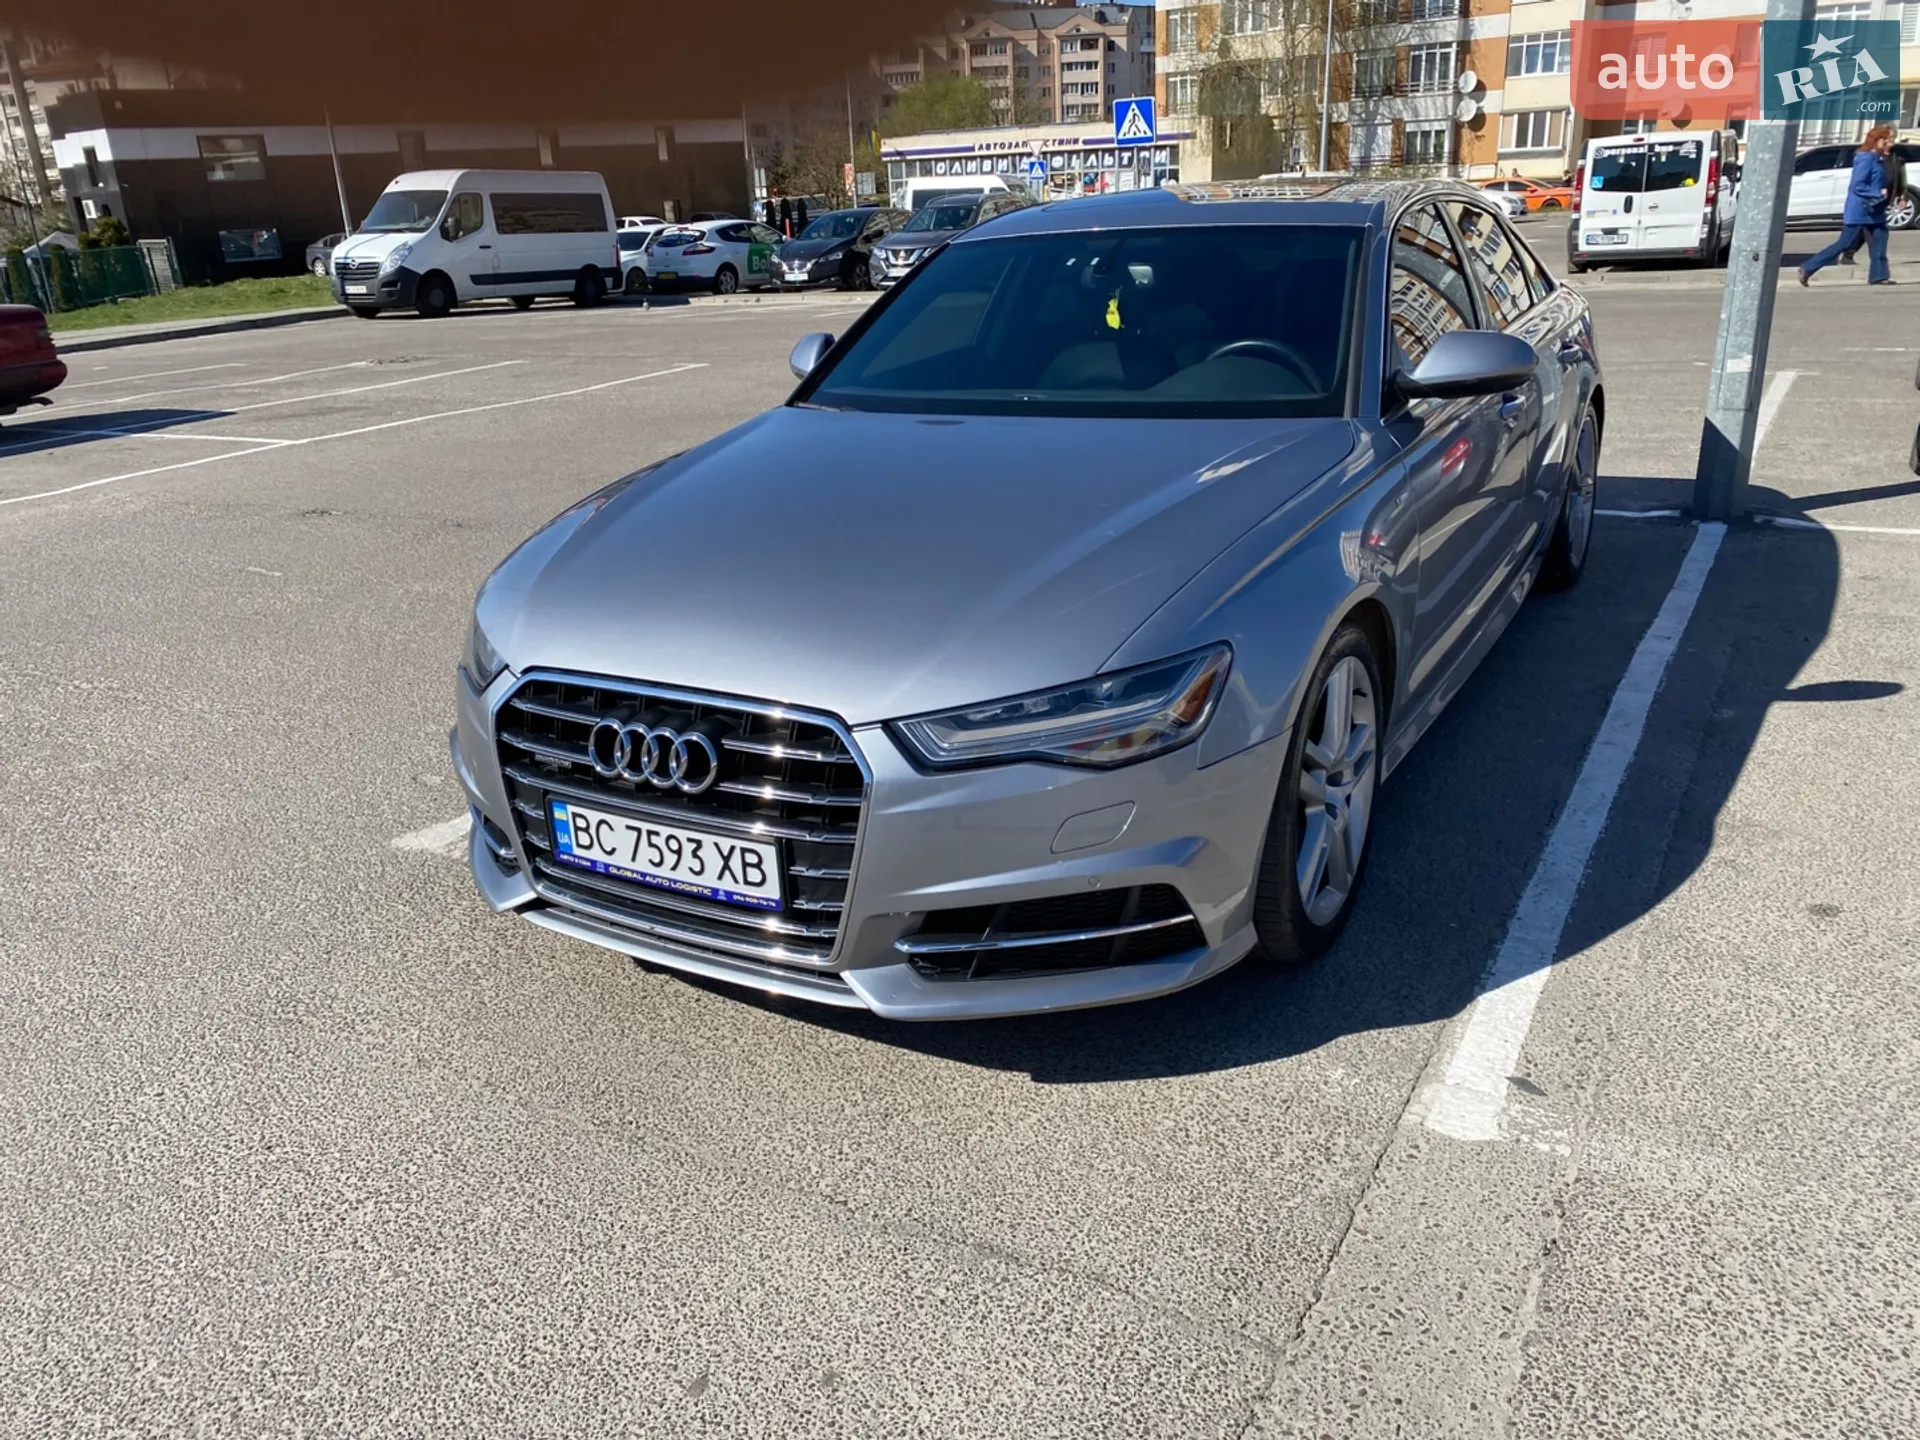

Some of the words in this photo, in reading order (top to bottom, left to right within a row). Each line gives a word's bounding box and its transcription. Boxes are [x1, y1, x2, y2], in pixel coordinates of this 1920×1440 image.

[978, 137, 1080, 151] АВТОЗАПСТИНИ
[936, 158, 1008, 174] ОЛИВИ
[752, 254, 771, 271] Bol
[557, 832, 571, 846] UA
[571, 812, 617, 856] BC
[625, 825, 705, 877] 7593
[713, 841, 767, 888] XB
[608, 866, 644, 880] GLOBAL
[645, 876, 670, 886] AUTO
[670, 881, 712, 895] LOGISTIC
